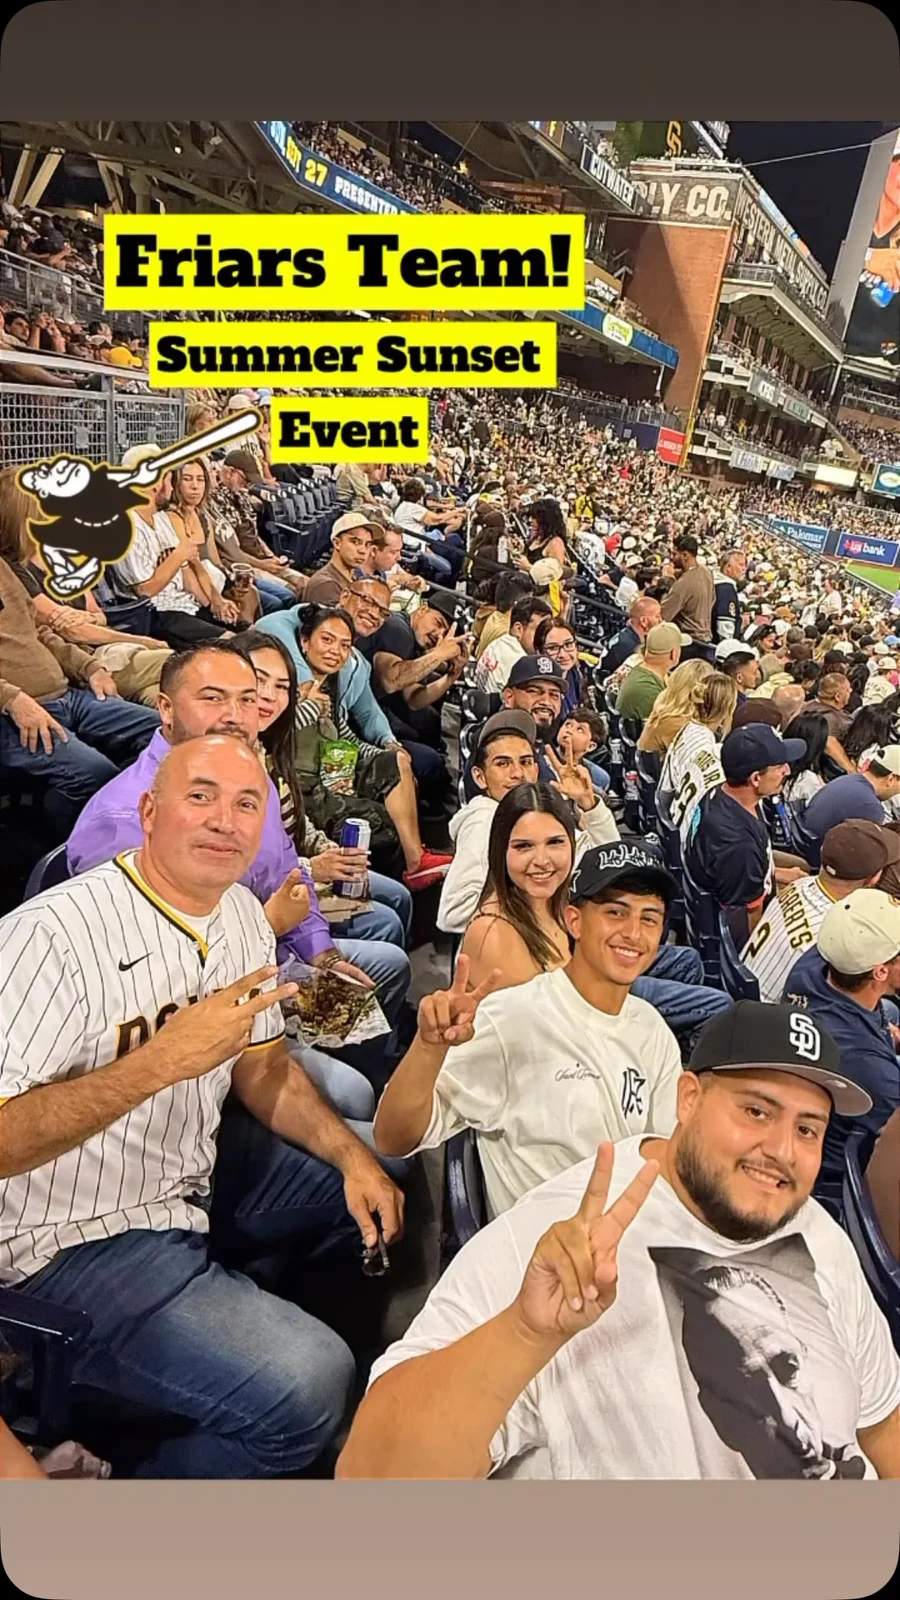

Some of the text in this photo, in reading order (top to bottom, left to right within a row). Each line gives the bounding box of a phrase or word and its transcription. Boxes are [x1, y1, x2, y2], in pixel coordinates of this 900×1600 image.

[304, 158, 328, 188] 27
[589, 154, 636, 207] CUTWATER
[686, 185, 732, 220] CO.
[736, 189, 776, 250] WESTERN
[787, 527, 824, 543] Palomar
[703, 768, 721, 789] JR.
[742, 922, 771, 961] 2
[789, 1012, 821, 1061] SD
